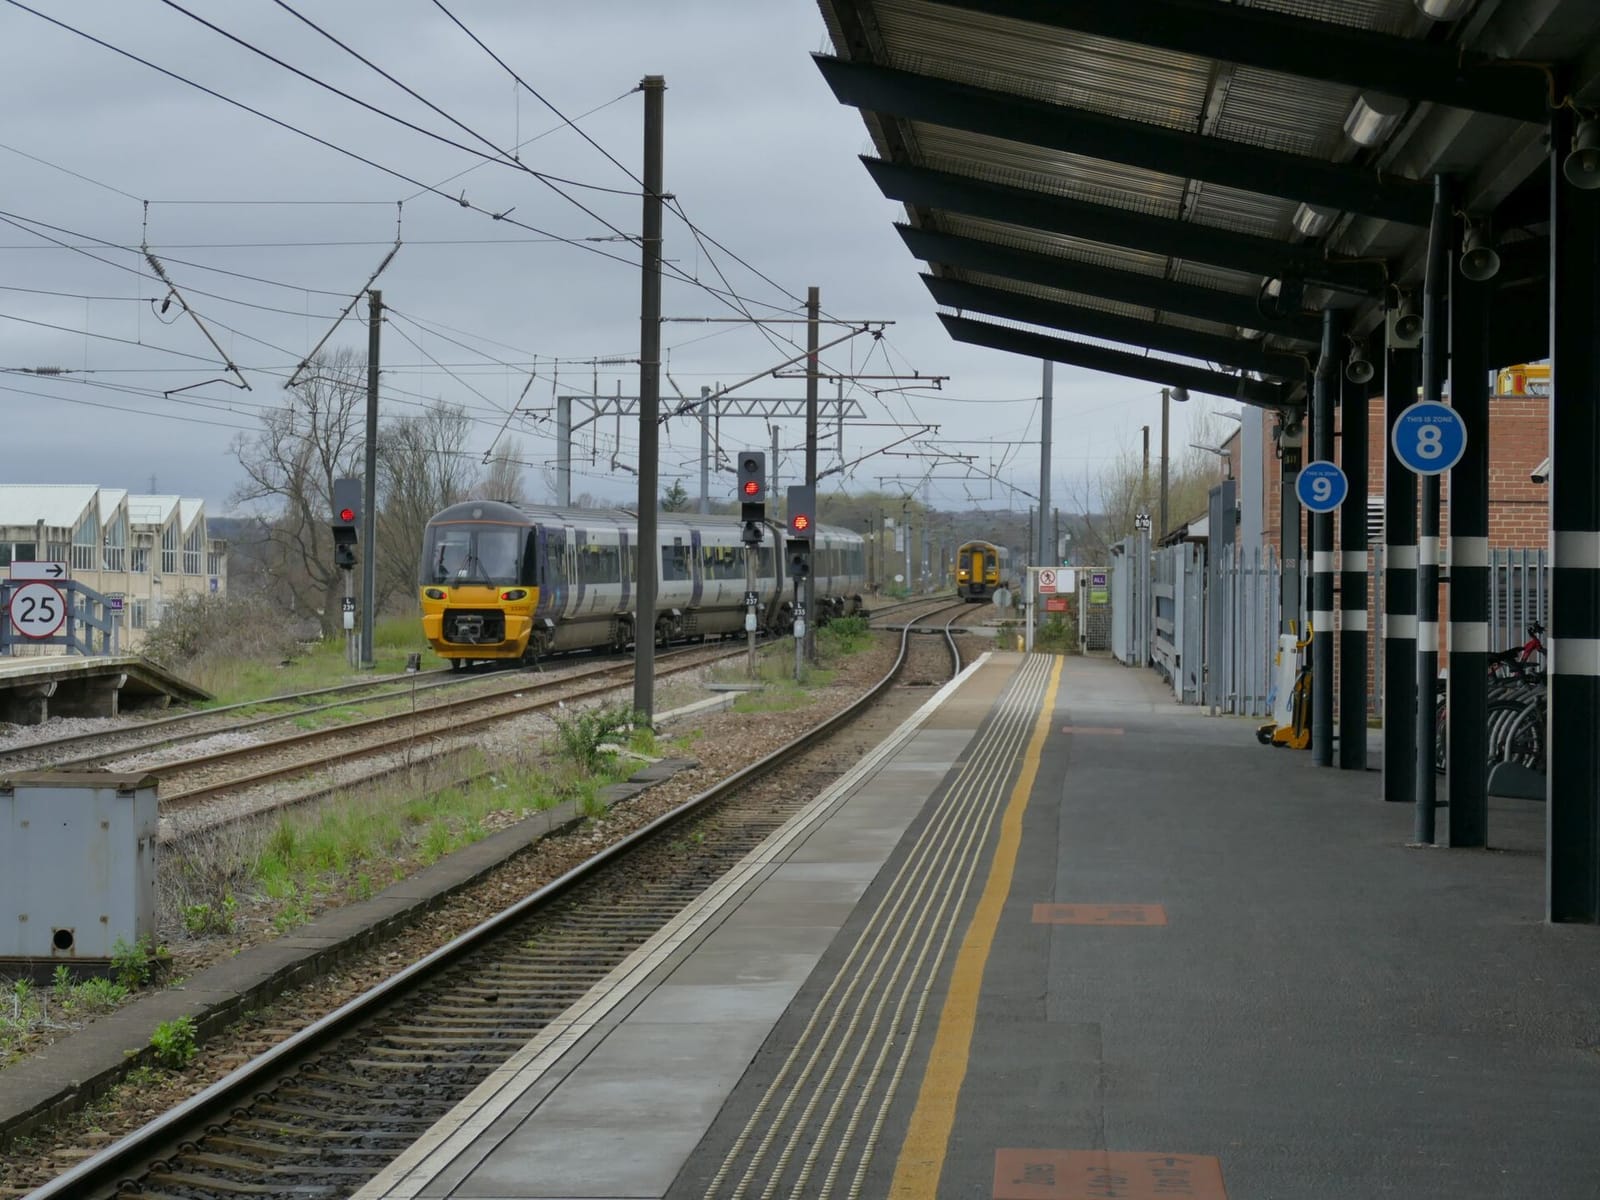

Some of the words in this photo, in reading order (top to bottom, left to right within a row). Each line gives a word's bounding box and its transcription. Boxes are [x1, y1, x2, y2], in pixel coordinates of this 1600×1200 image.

[1416, 424, 1443, 459] 8
[1312, 477, 1332, 502] 9
[20, 596, 55, 623] 25
